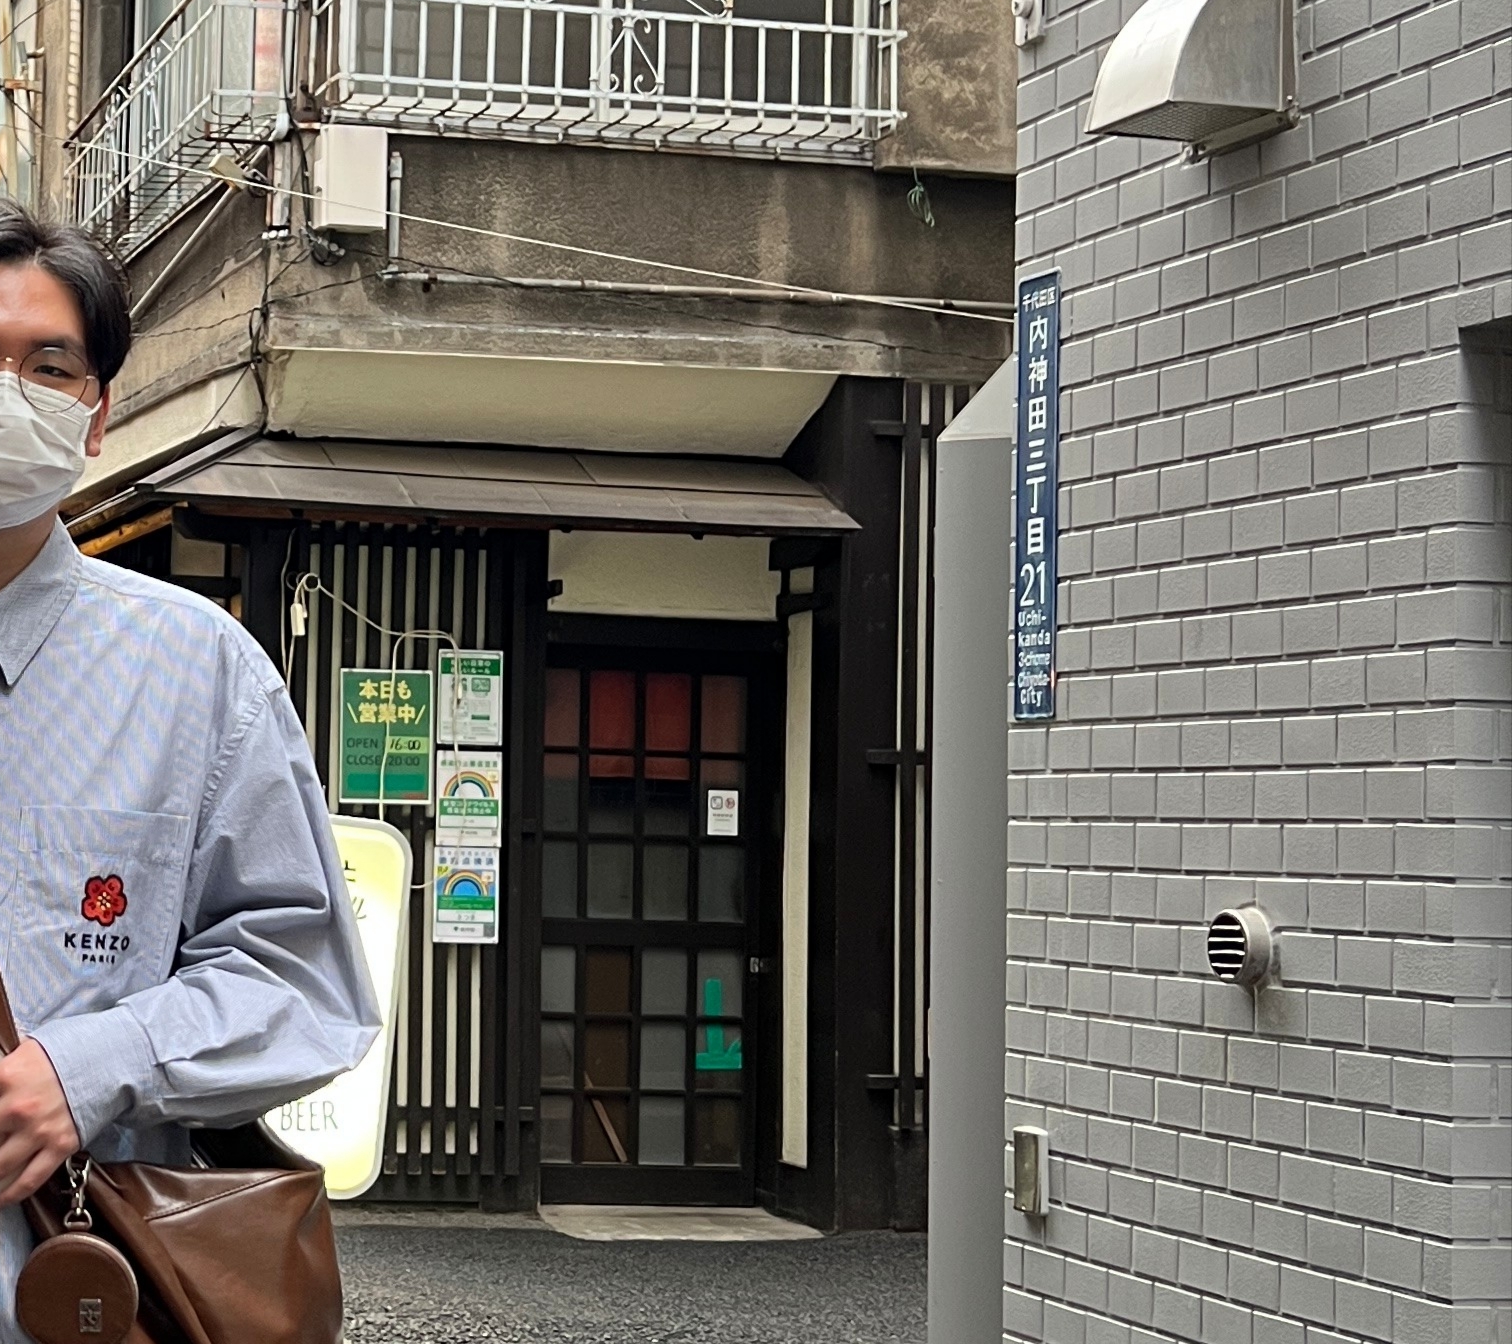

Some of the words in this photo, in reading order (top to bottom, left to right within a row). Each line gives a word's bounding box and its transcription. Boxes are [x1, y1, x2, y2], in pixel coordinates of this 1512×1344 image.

[1022, 286, 1056, 313] 千代田区
[1017, 609, 1047, 627] Uchi-
[1017, 631, 1051, 647] kanda
[358, 678, 412, 700] 本日も
[1020, 687, 1043, 707] City
[358, 702, 416, 725] 営業中
[346, 737, 378, 749] OPEN
[389, 737, 421, 751] 16:00
[346, 754, 381, 766] CLOSE
[388, 755, 421, 767] 20:00
[64, 931, 131, 952] KENZO
[81, 953, 116, 965] PARIS
[280, 1100, 339, 1132] BEER
